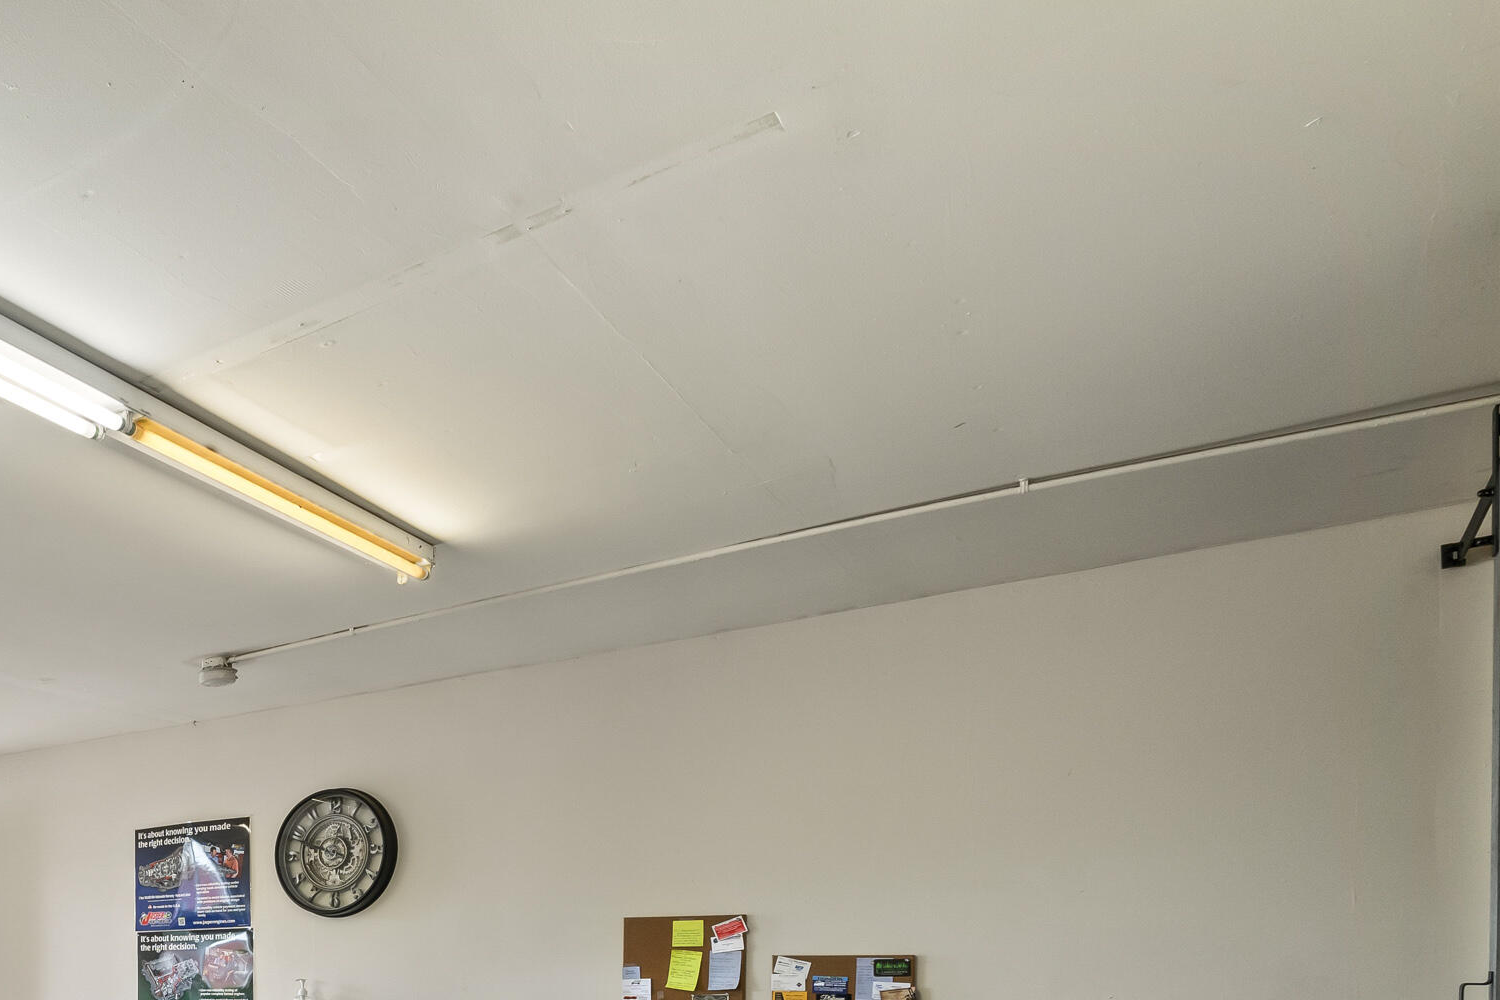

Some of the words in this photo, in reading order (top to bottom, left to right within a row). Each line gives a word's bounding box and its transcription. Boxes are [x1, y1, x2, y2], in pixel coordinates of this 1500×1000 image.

[138, 832, 147, 840] It's
[148, 830, 164, 839] about
[165, 826, 193, 836] knowing
[194, 825, 208, 835] you
[209, 822, 231, 830] made
[149, 839, 163, 849] right
[170, 934, 199, 942] knowing
[215, 932, 236, 940] made
[152, 943, 168, 953] right
